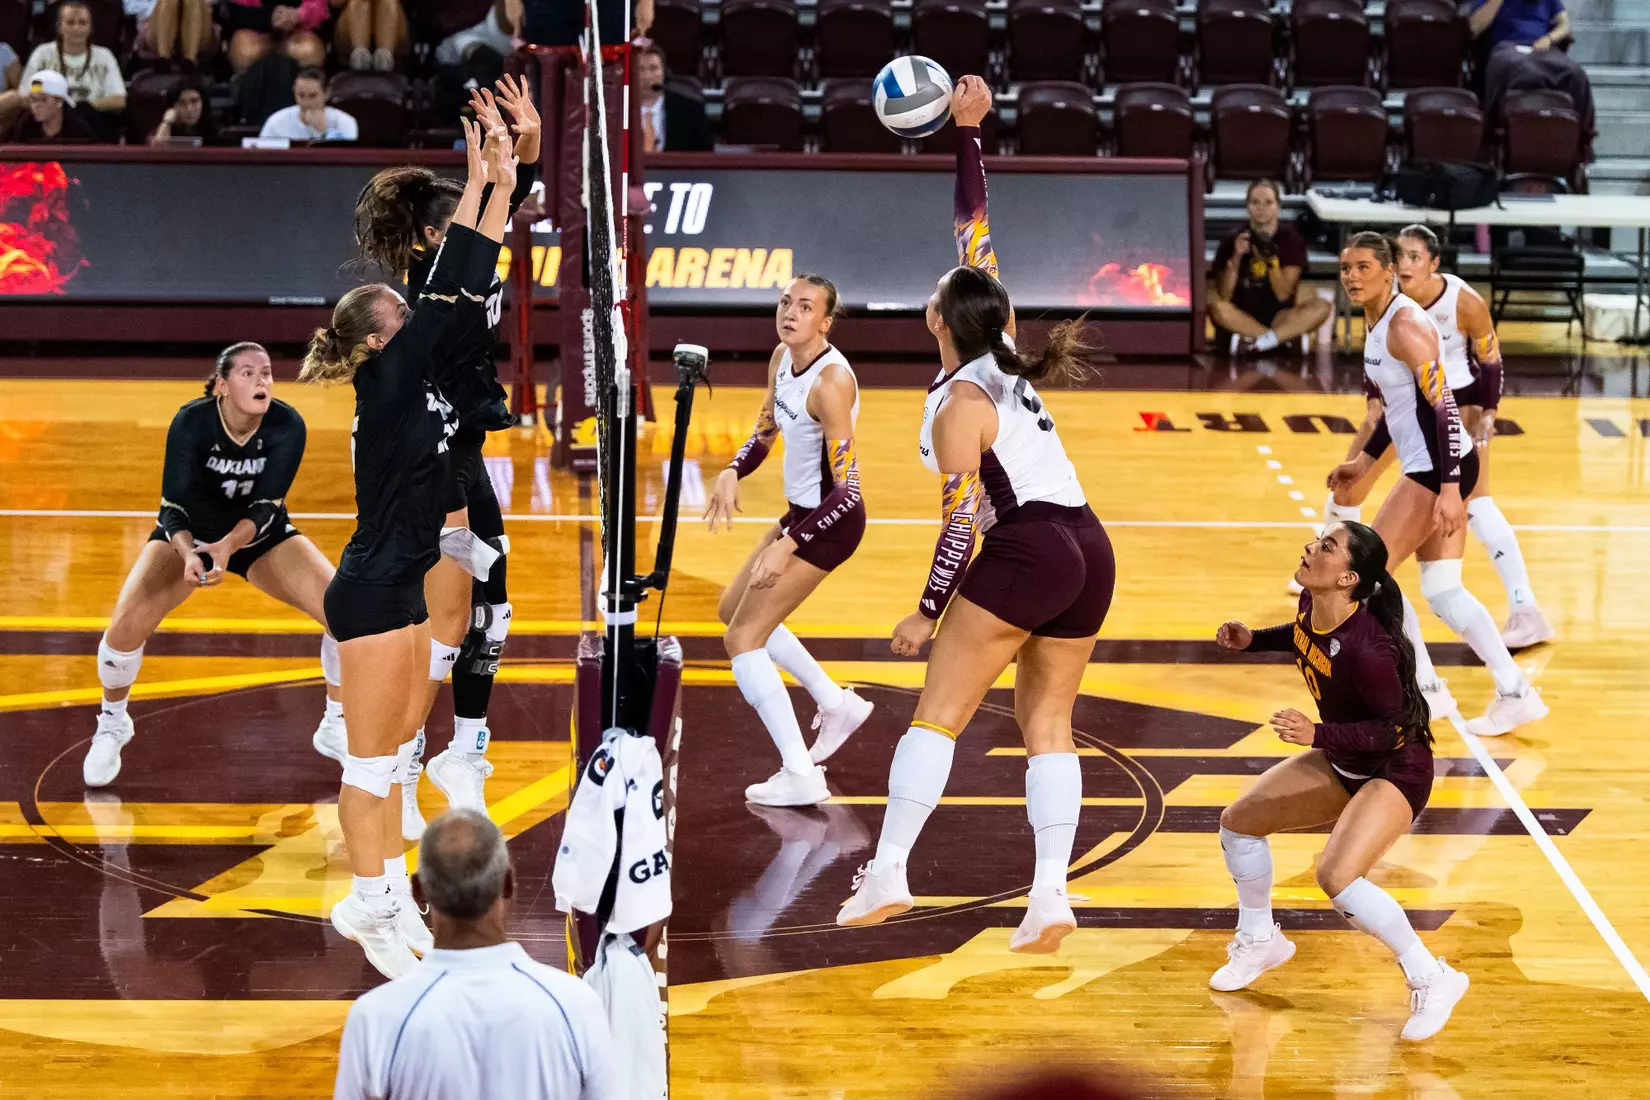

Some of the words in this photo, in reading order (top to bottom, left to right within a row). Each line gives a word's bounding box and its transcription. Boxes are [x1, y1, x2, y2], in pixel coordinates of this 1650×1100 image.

[664, 182, 714, 235] TO
[645, 247, 793, 289] ARENA
[929, 511, 974, 595] CHIPPEWAS
